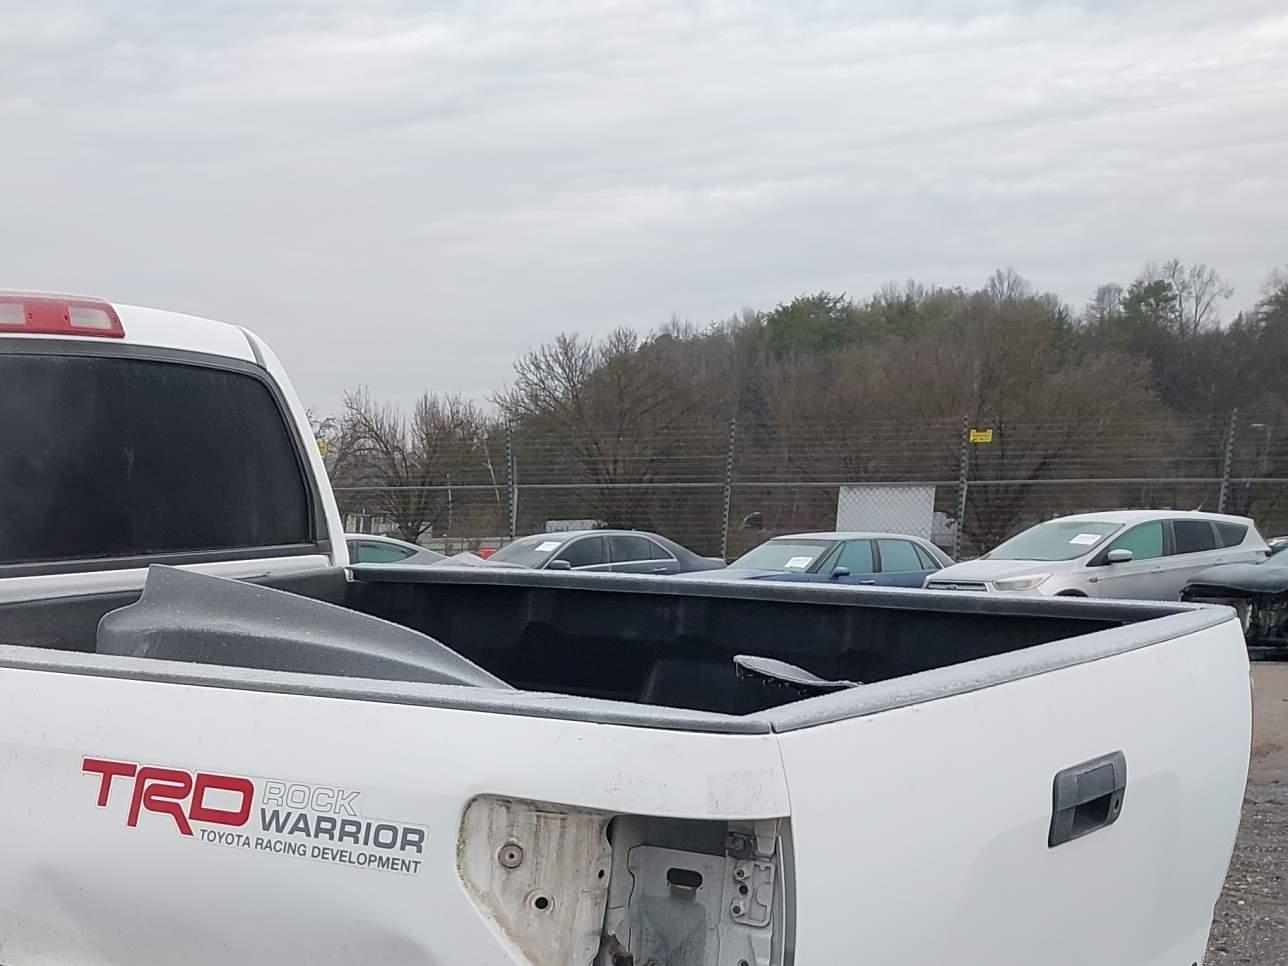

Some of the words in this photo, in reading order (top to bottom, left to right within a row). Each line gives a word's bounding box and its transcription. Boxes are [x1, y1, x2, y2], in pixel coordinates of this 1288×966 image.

[81, 756, 255, 836] TRD
[263, 780, 361, 817] ROCK
[200, 829, 252, 848] TOYOTA
[255, 837, 307, 856] RACING
[311, 846, 421, 874] DEVELOPMENT
[260, 808, 426, 854] WARRIOR
